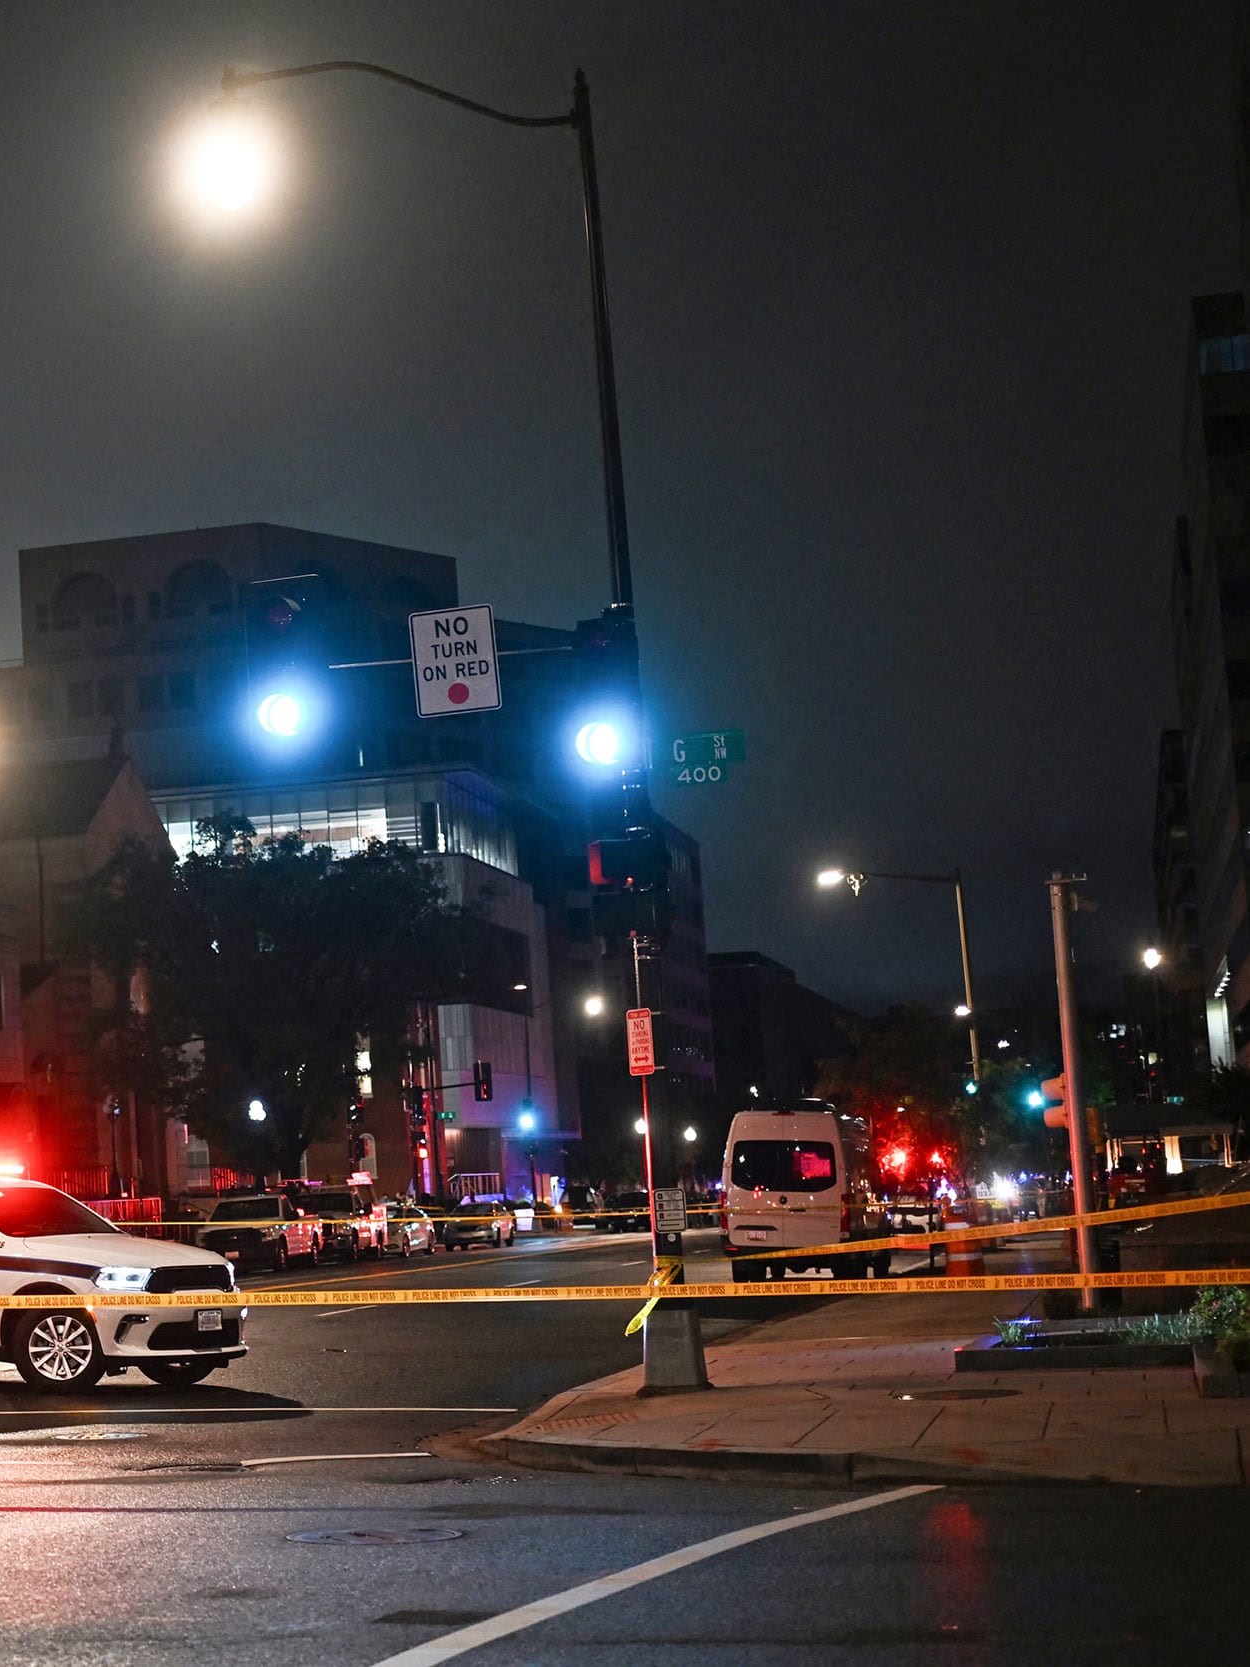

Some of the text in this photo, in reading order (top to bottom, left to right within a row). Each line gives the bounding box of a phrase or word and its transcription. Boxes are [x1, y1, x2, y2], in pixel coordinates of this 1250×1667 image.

[434, 616, 468, 638] NO
[431, 640, 478, 659] TURN
[423, 660, 489, 681] ON RED
[673, 739, 686, 762] G
[714, 747, 727, 760] NW
[677, 766, 721, 783] 400
[633, 1020, 645, 1030] NO
[1004, 1278, 1023, 1288] POLICE
[1024, 1278, 1035, 1288] LINE
[1057, 1277, 1075, 1287] CROSS
[1094, 1275, 1112, 1286] POLICE
[1113, 1274, 1125, 1285] LINE
[1148, 1273, 1165, 1284] CROSS
[1185, 1272, 1204, 1284] POLICE
[1205, 1272, 1217, 1283] LINE
[743, 1284, 760, 1294] POLICE
[761, 1284, 772, 1294] LINE
[794, 1283, 811, 1292] CROSS
[829, 1282, 847, 1292] POLICE
[848, 1282, 859, 1291] LINE
[880, 1281, 897, 1290] CROSS
[916, 1280, 934, 1290] POLICE
[935, 1280, 946, 1289] LINE
[968, 1279, 985, 1289] CROSS
[413, 1292, 429, 1300] POLICE
[430, 1291, 440, 1300] LINE
[460, 1291, 476, 1299] CROSS
[576, 1288, 593, 1296] POLICE
[594, 1288, 604, 1296] LINE
[625, 1287, 641, 1296] CROSS
[659, 1286, 676, 1296] POLICE
[677, 1286, 688, 1295] LINE
[709, 1285, 725, 1295] CROSS
[25, 1297, 40, 1306] POLICE
[41, 1297, 51, 1306] LINE
[70, 1296, 84, 1305] CROSS
[100, 1296, 116, 1305] POLICE
[117, 1296, 127, 1305] LINE
[146, 1295, 160, 1305] CROSS
[176, 1295, 192, 1304] POLICE
[193, 1295, 204, 1304] LINE
[223, 1294, 238, 1304] CROSS
[254, 1294, 270, 1303] POLICE
[271, 1294, 281, 1303] LINE
[301, 1294, 316, 1302] CROSS
[333, 1293, 349, 1302] POLICE
[350, 1293, 360, 1302] LINE
[380, 1292, 395, 1301] CROSS
